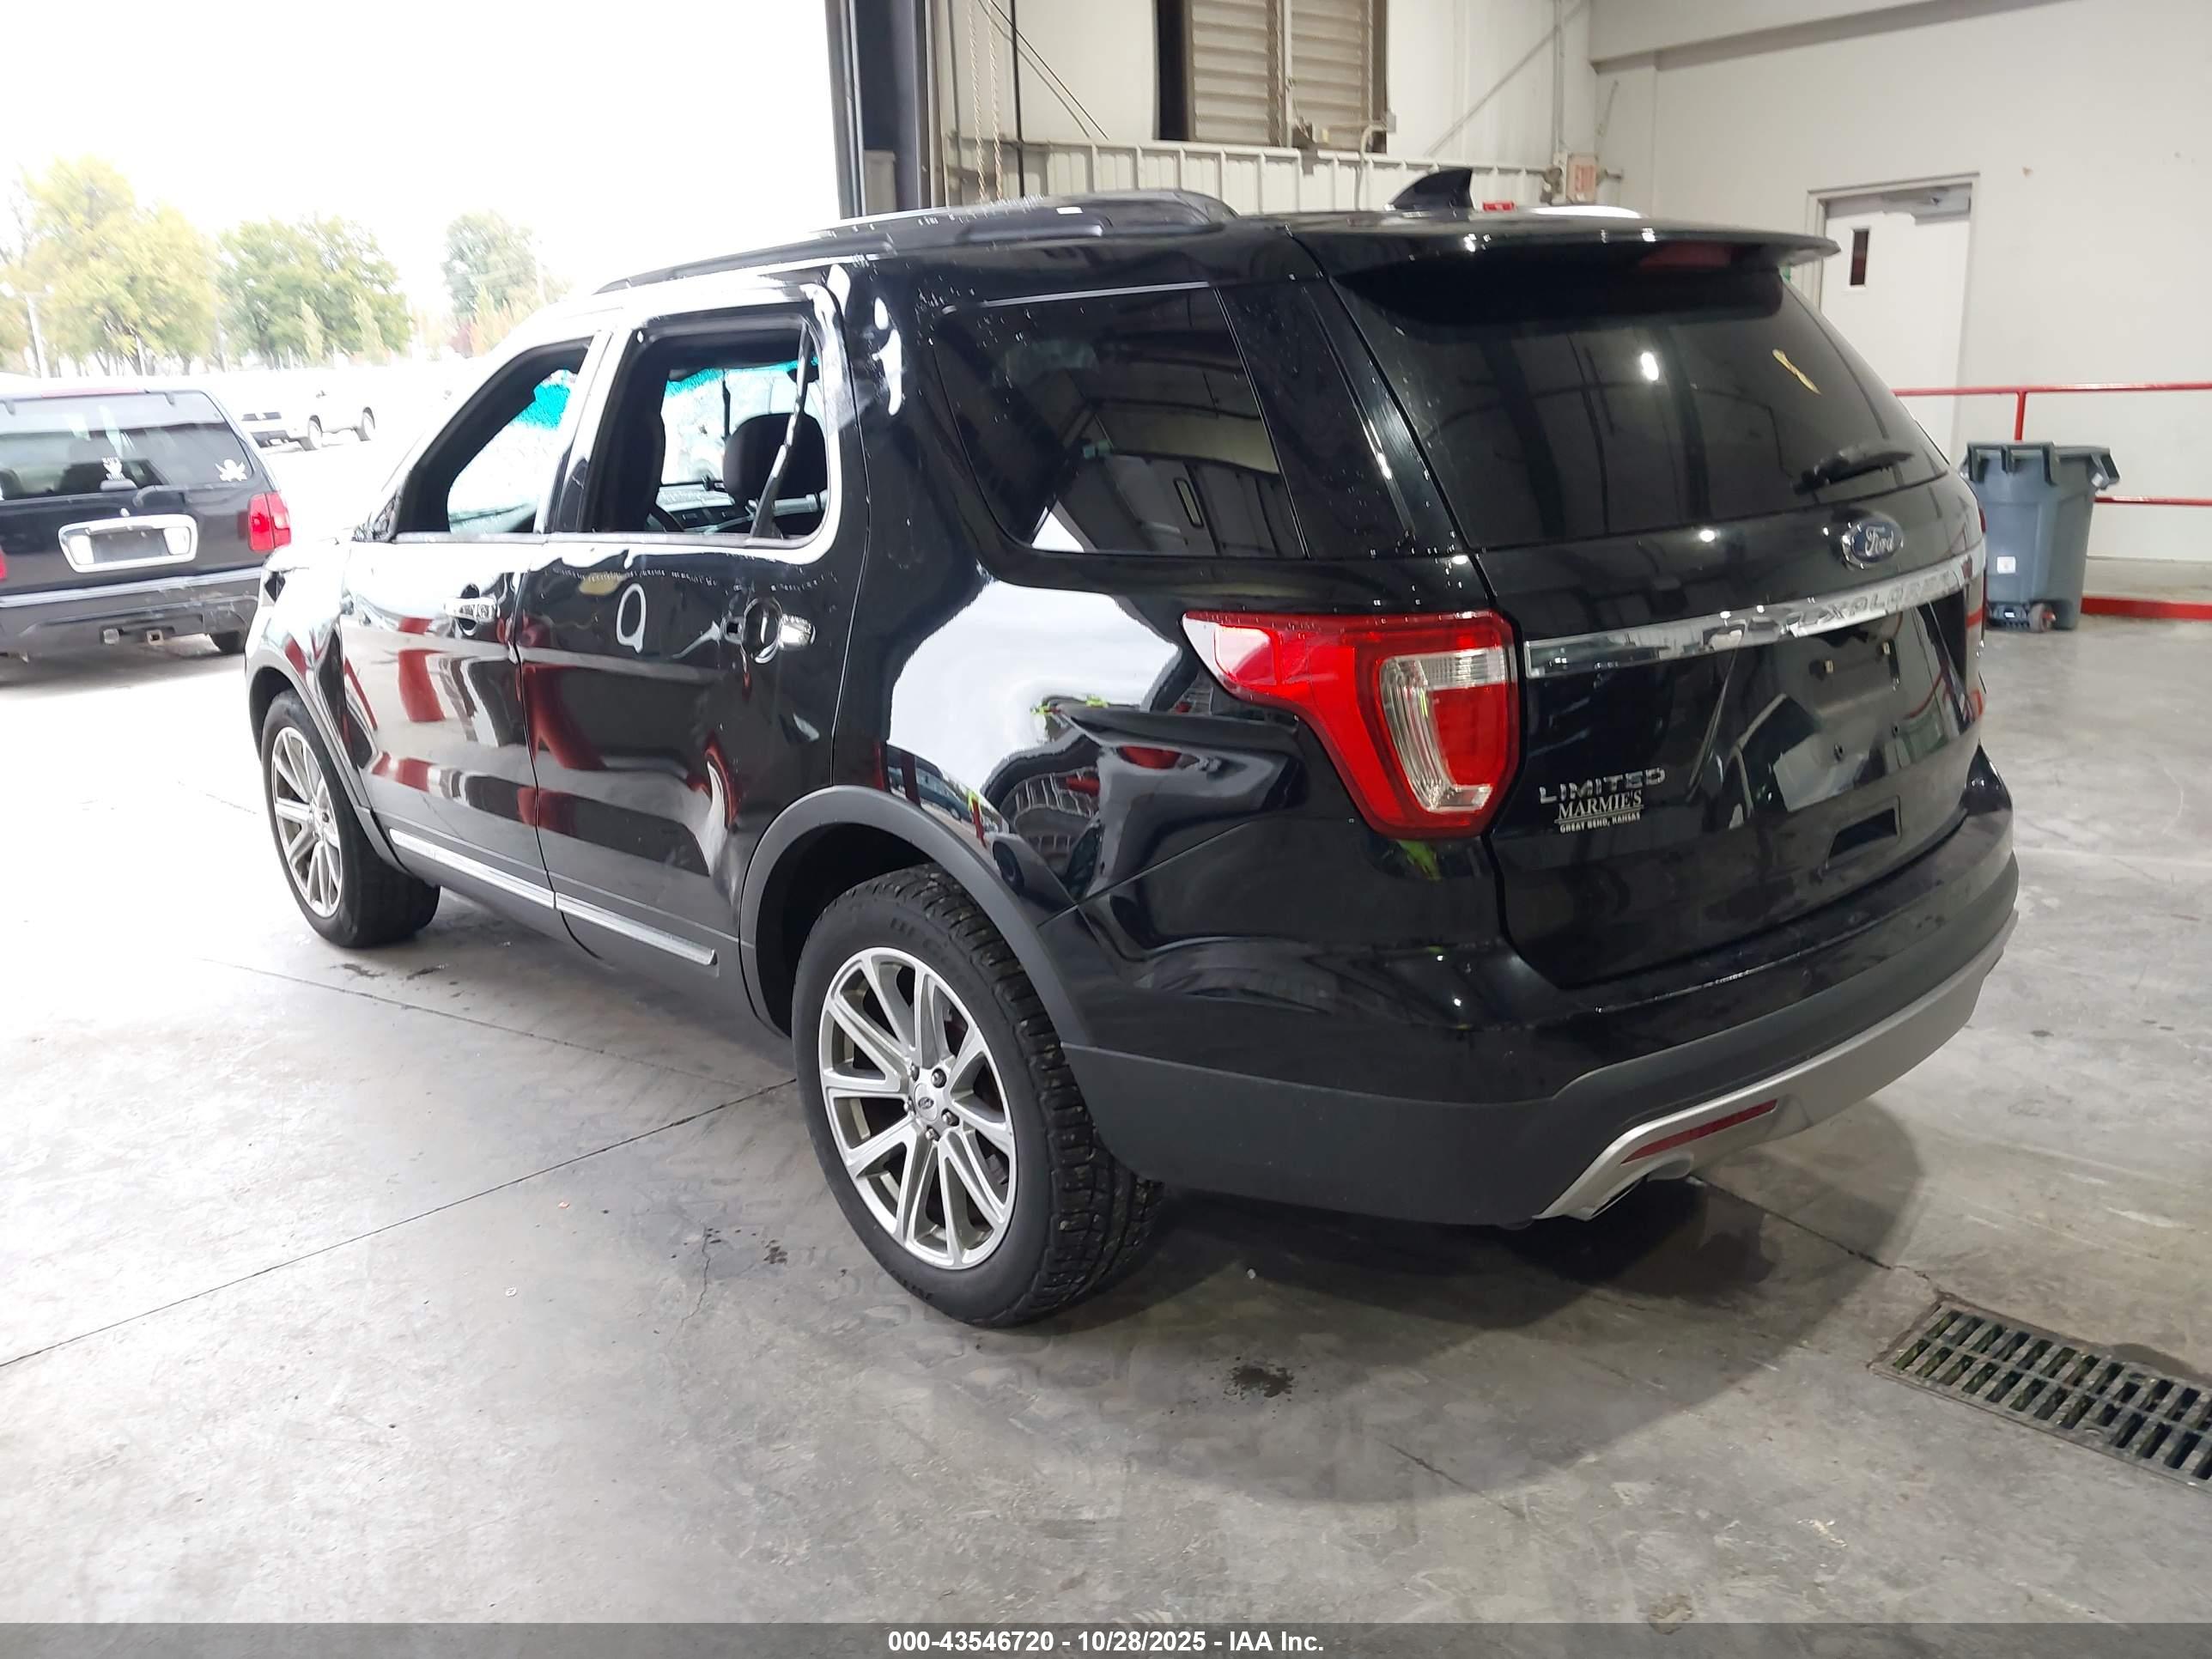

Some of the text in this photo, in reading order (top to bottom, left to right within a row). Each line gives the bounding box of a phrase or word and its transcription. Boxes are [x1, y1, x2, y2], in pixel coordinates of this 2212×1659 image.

[1864, 526, 1894, 556] Ford
[1539, 767, 1666, 804] LIMITED
[1558, 789, 1642, 820] MARMIE'S
[1559, 822, 1585, 834] GREAT
[1612, 811, 1641, 824] KANSAS
